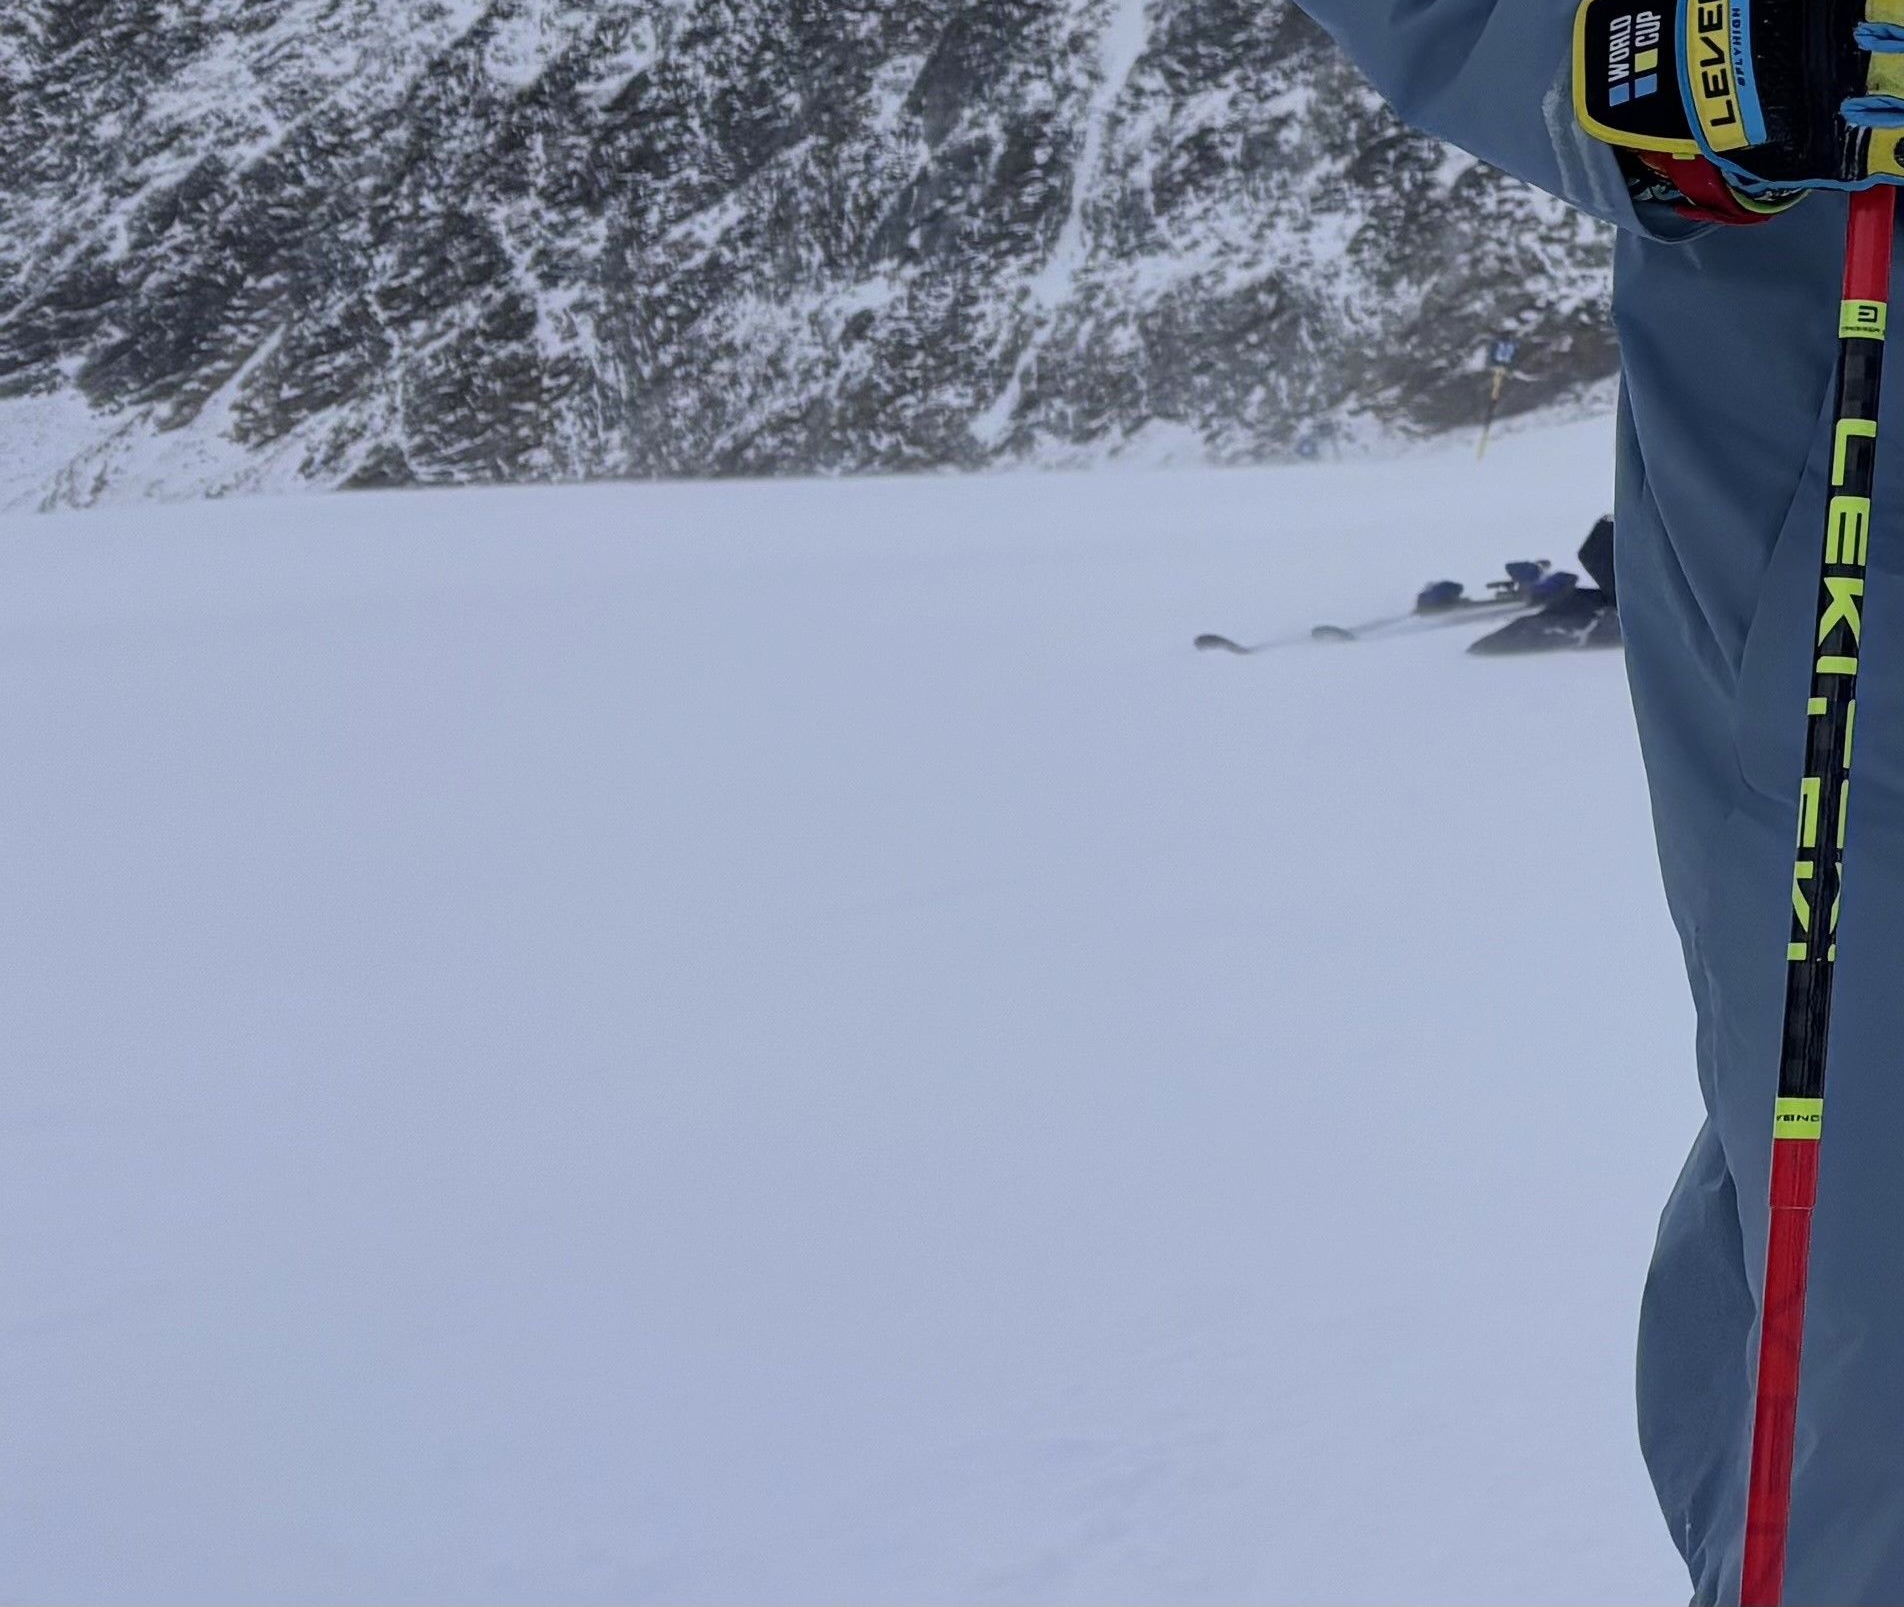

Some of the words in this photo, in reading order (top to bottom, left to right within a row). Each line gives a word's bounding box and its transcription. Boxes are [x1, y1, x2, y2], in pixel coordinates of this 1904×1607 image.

[1607, 14, 1633, 83] WORLD
[1634, 10, 1662, 48] CUP
[1815, 418, 1878, 676] LEKI
